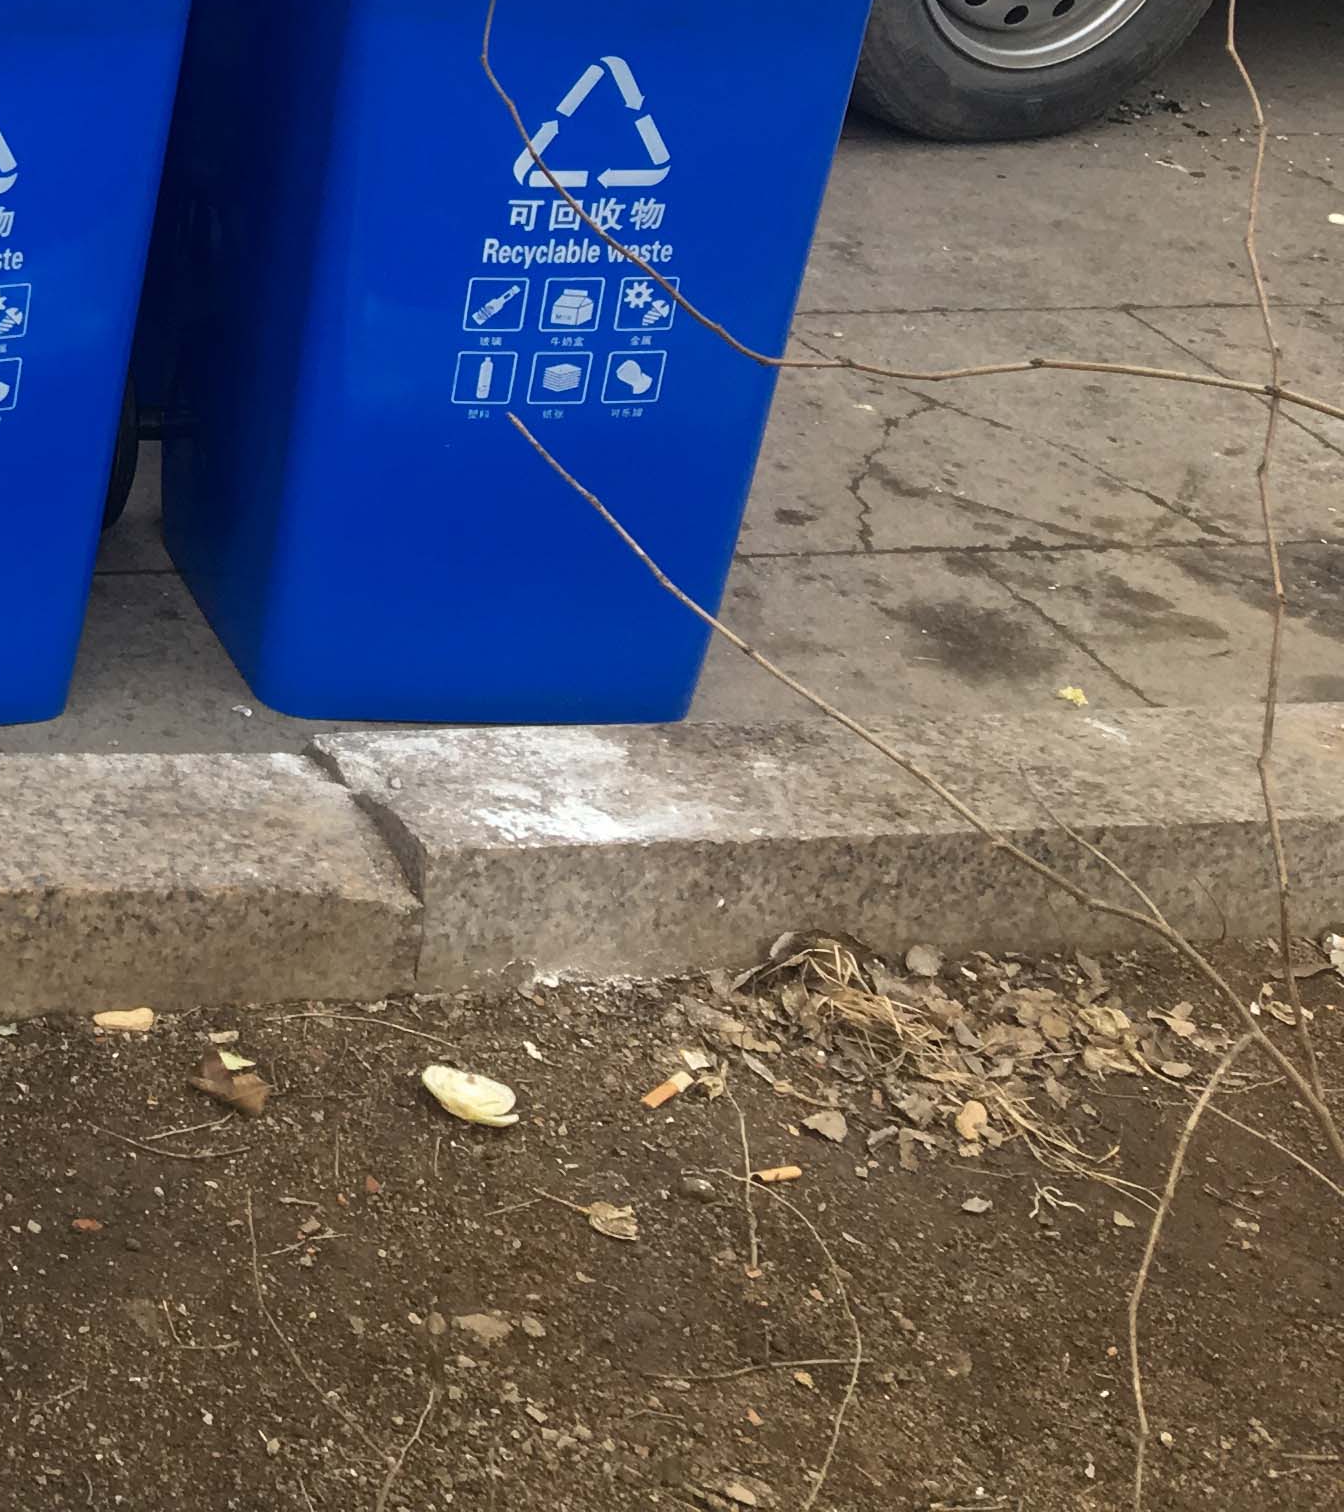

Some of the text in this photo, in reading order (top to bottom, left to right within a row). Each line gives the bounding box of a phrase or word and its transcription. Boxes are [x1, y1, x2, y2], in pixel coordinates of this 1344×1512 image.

[509, 197, 665, 231] 可回收物
[482, 238, 673, 269] Recyclable waste
